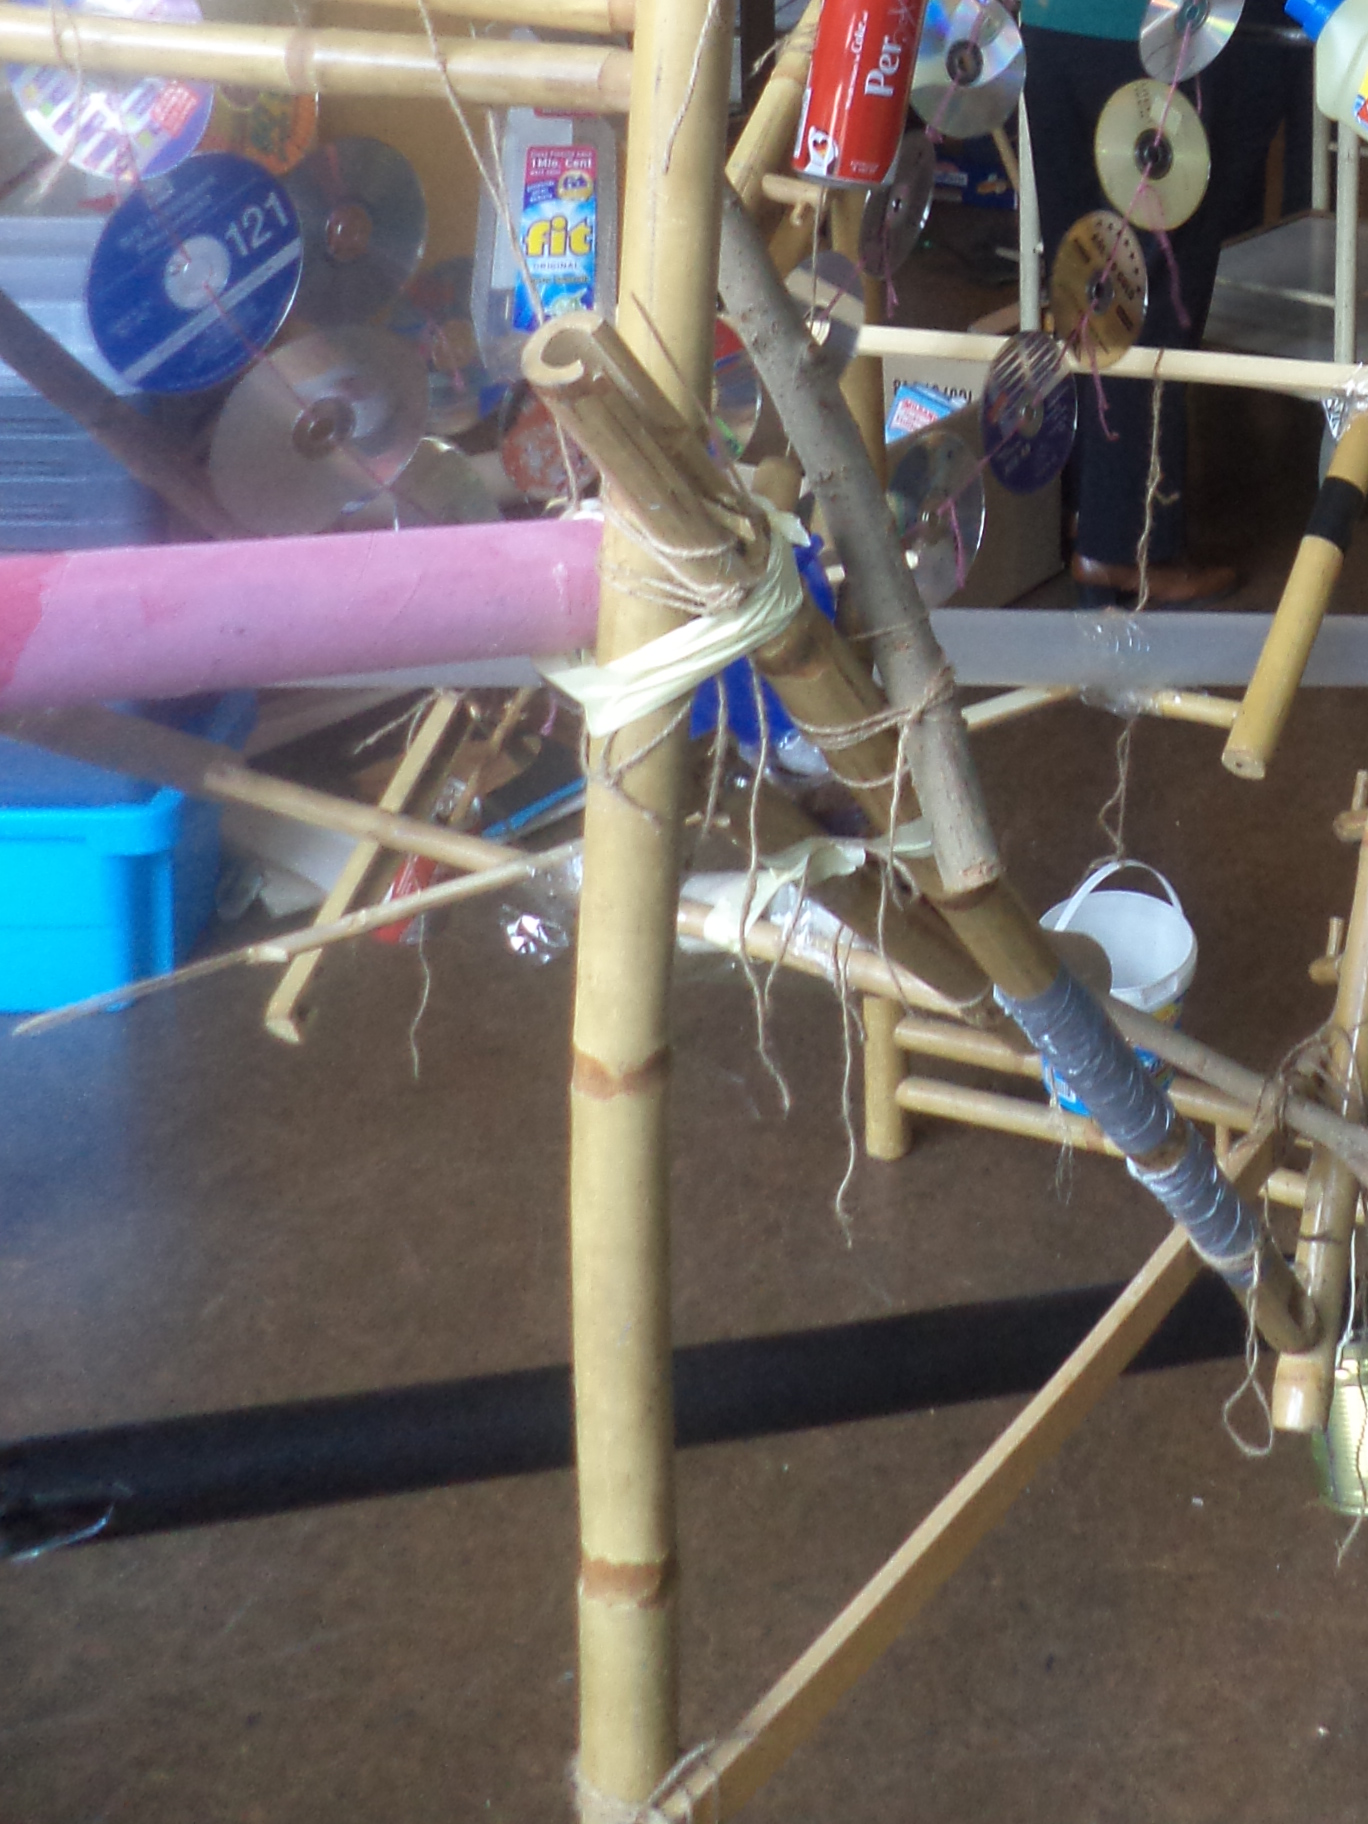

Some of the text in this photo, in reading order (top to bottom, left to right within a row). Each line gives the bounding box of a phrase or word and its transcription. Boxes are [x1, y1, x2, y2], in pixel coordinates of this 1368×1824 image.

[864, 34, 901, 98] Per
[225, 191, 289, 257] 121
[525, 215, 593, 257] fit
